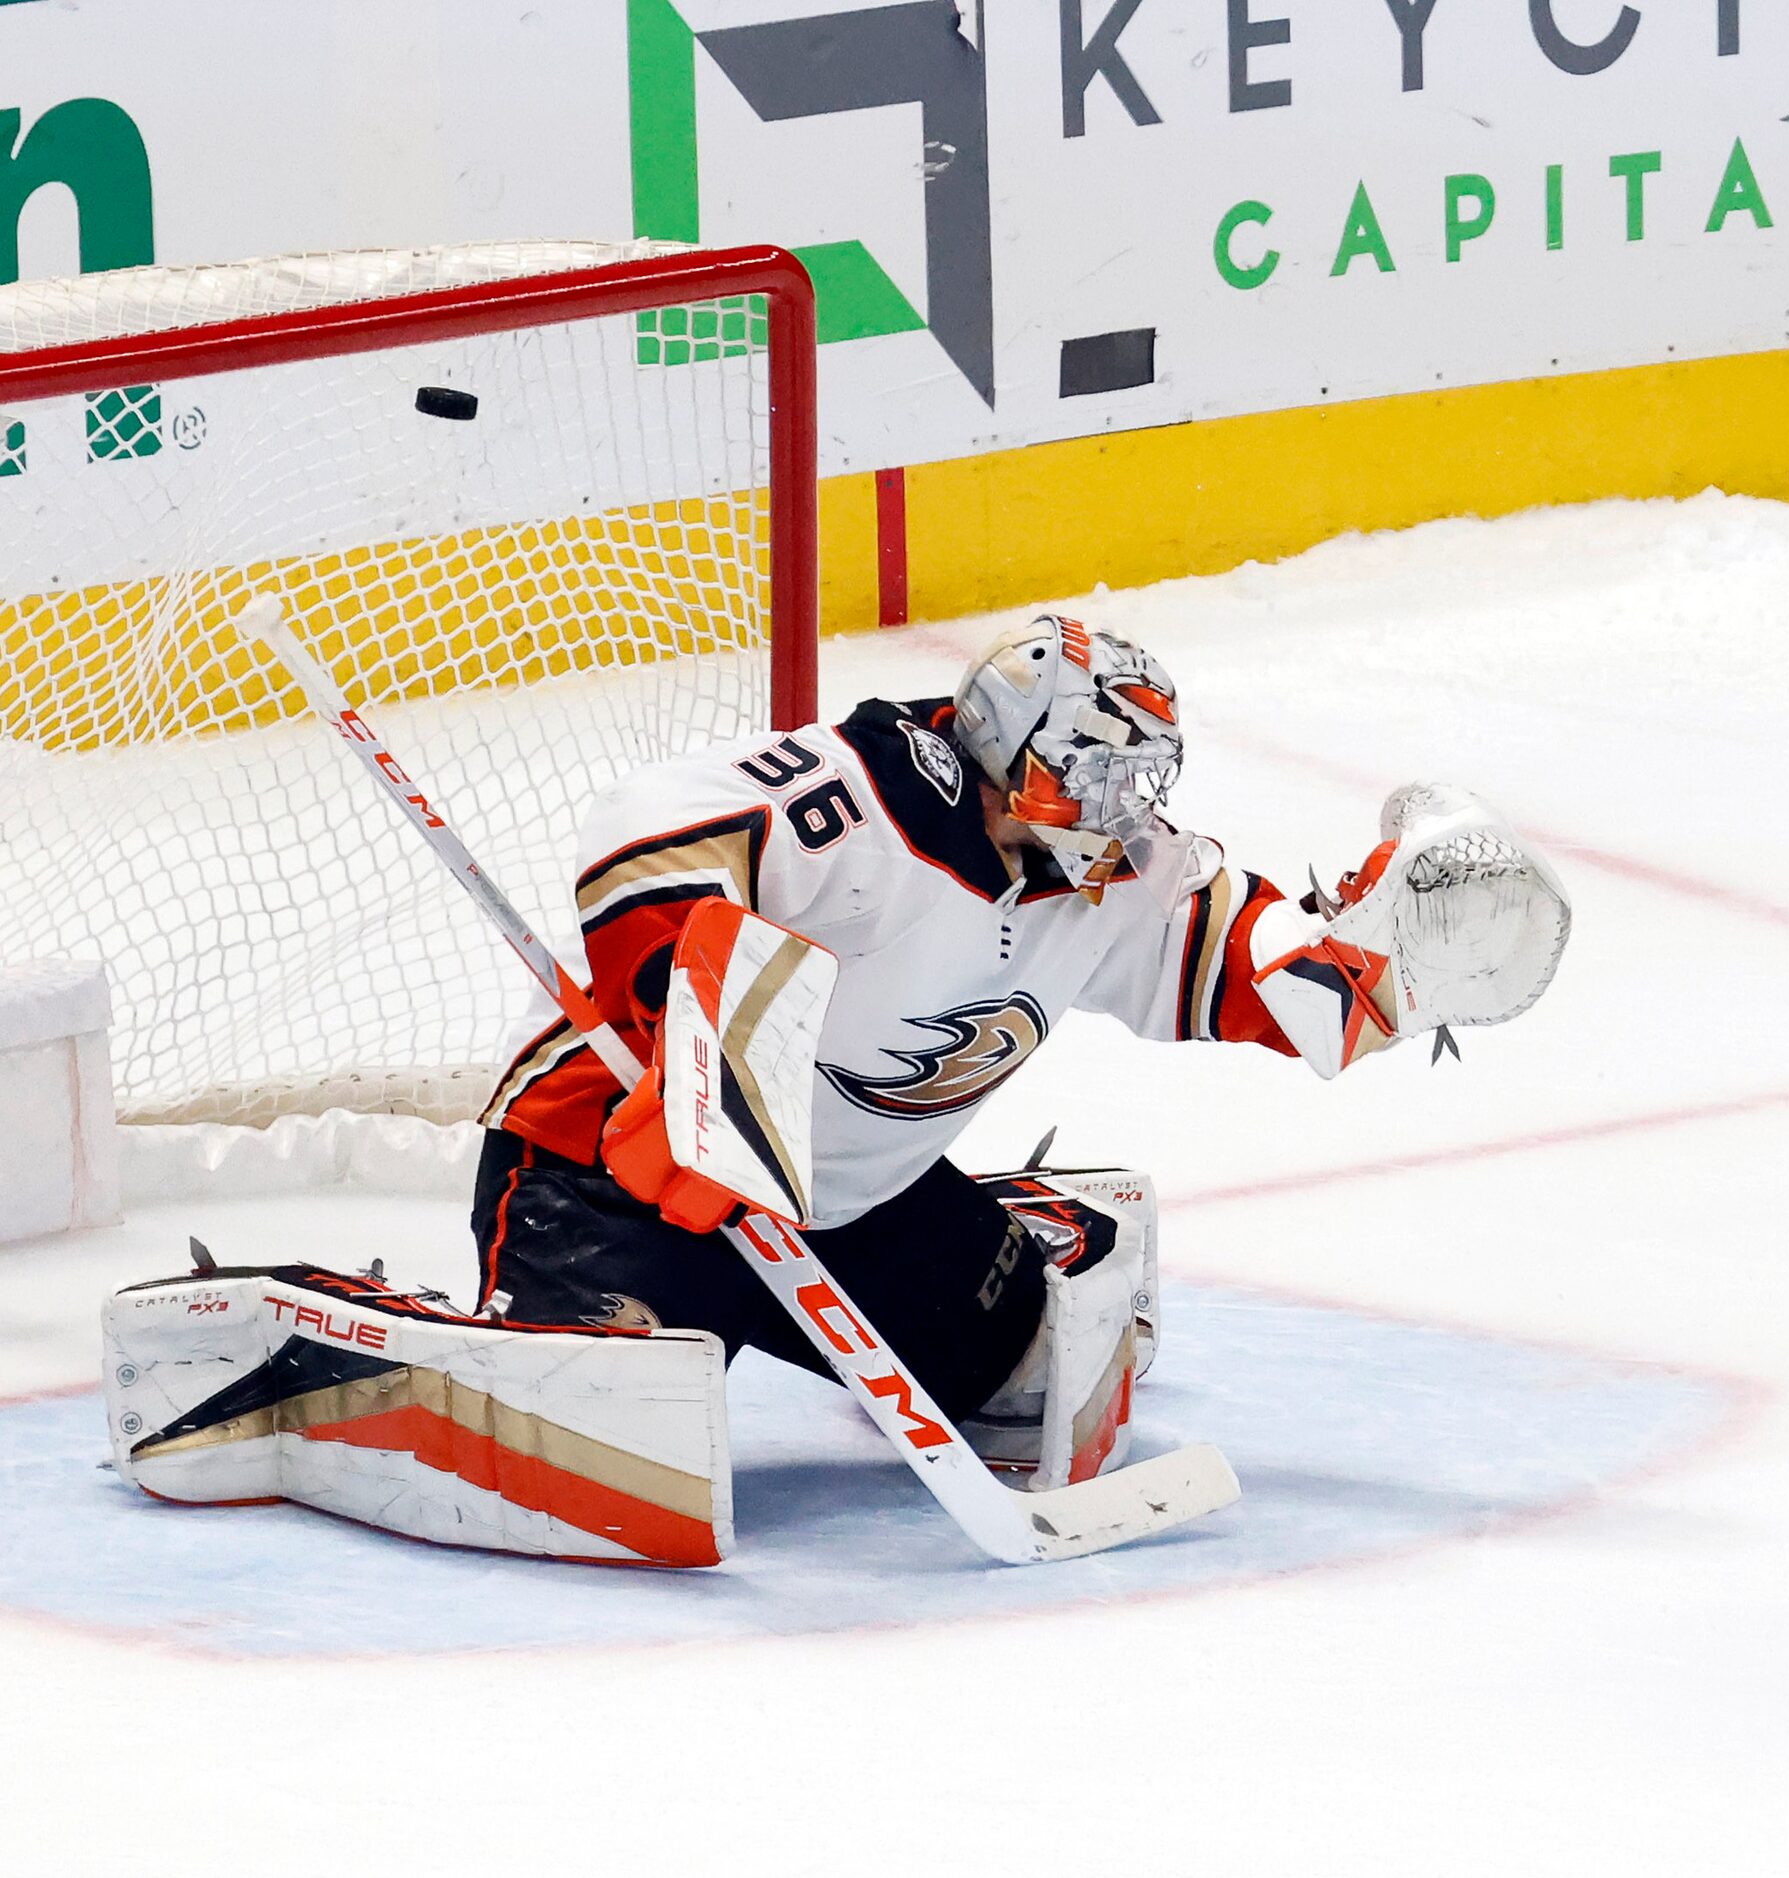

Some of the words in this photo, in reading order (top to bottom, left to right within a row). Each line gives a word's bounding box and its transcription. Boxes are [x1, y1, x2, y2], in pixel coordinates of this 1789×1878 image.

[340, 709, 446, 828] CCM
[731, 732, 869, 853] 36
[694, 1035, 709, 1163] TRUE
[135, 1291, 223, 1308] CATALYST
[263, 1296, 389, 1350] TRUE
[738, 1210, 955, 1449] CCM
